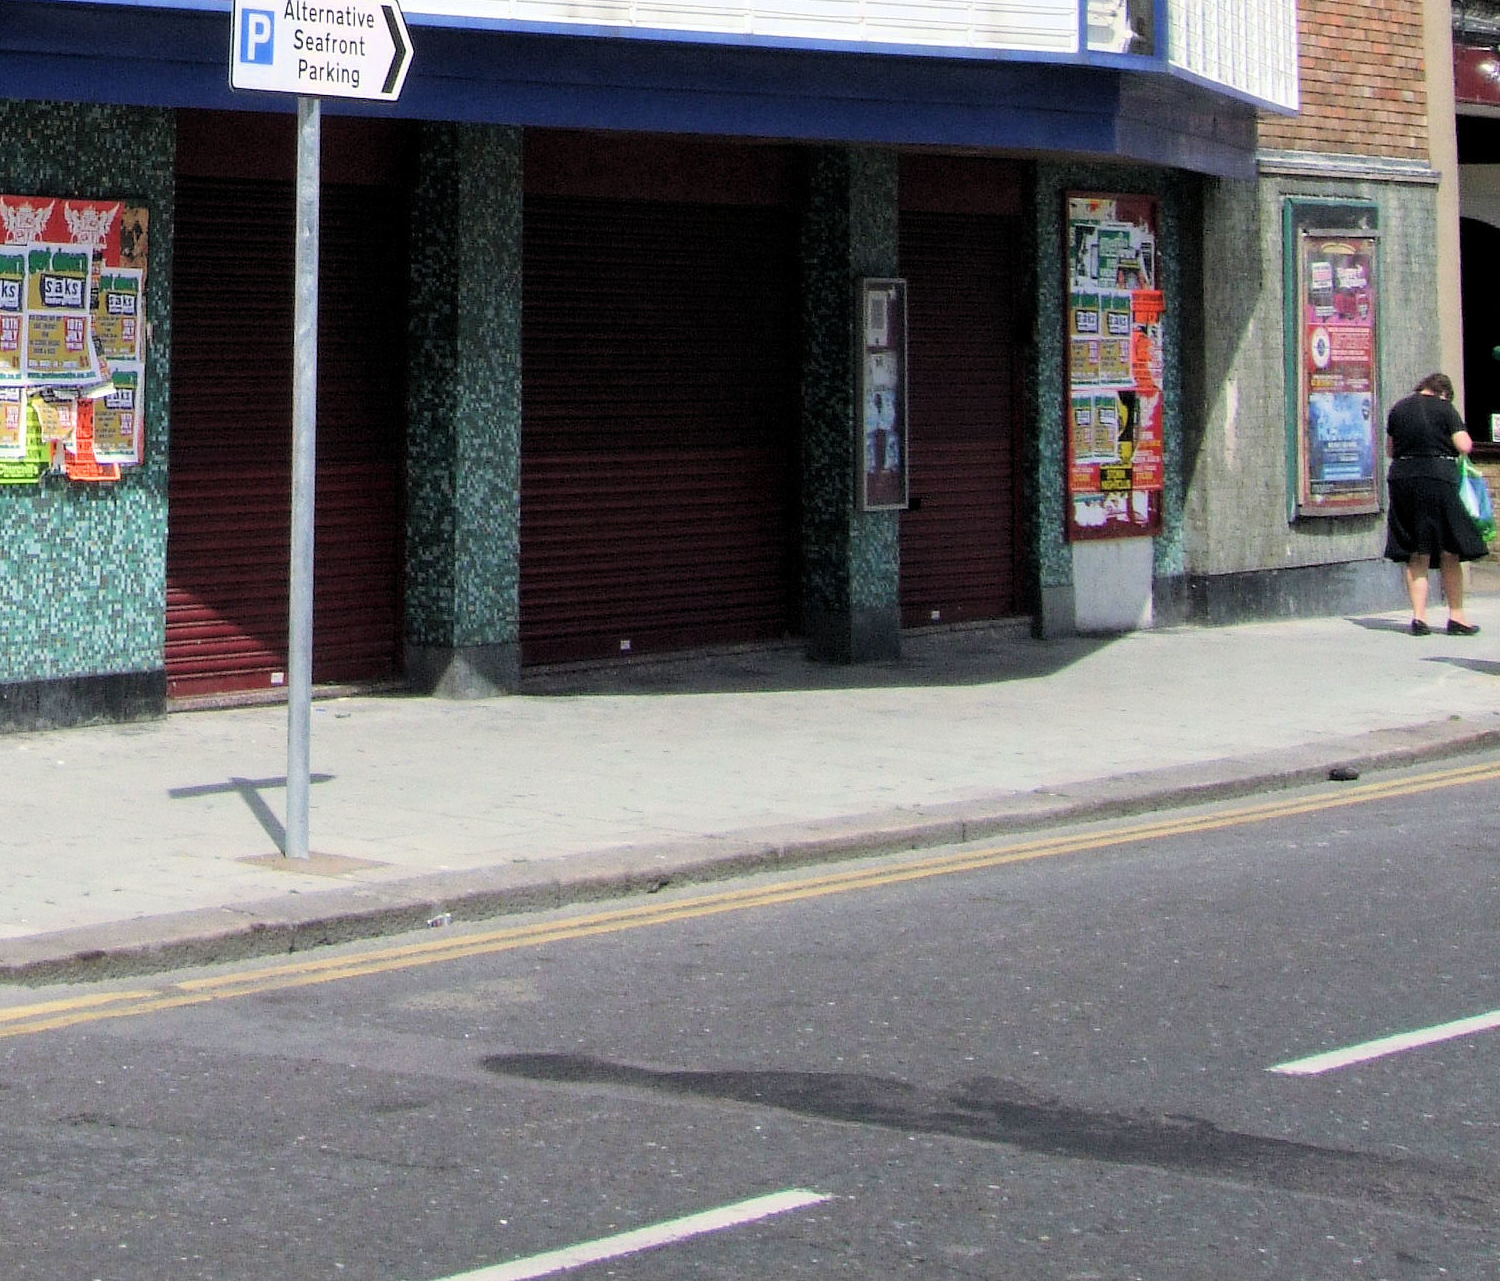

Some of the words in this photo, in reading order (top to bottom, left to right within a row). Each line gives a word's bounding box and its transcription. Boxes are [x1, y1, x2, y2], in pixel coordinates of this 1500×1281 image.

[247, 12, 271, 61] P
[293, 30, 366, 57] Seafront
[297, 59, 361, 89] Parking
[45, 279, 79, 294] saks
